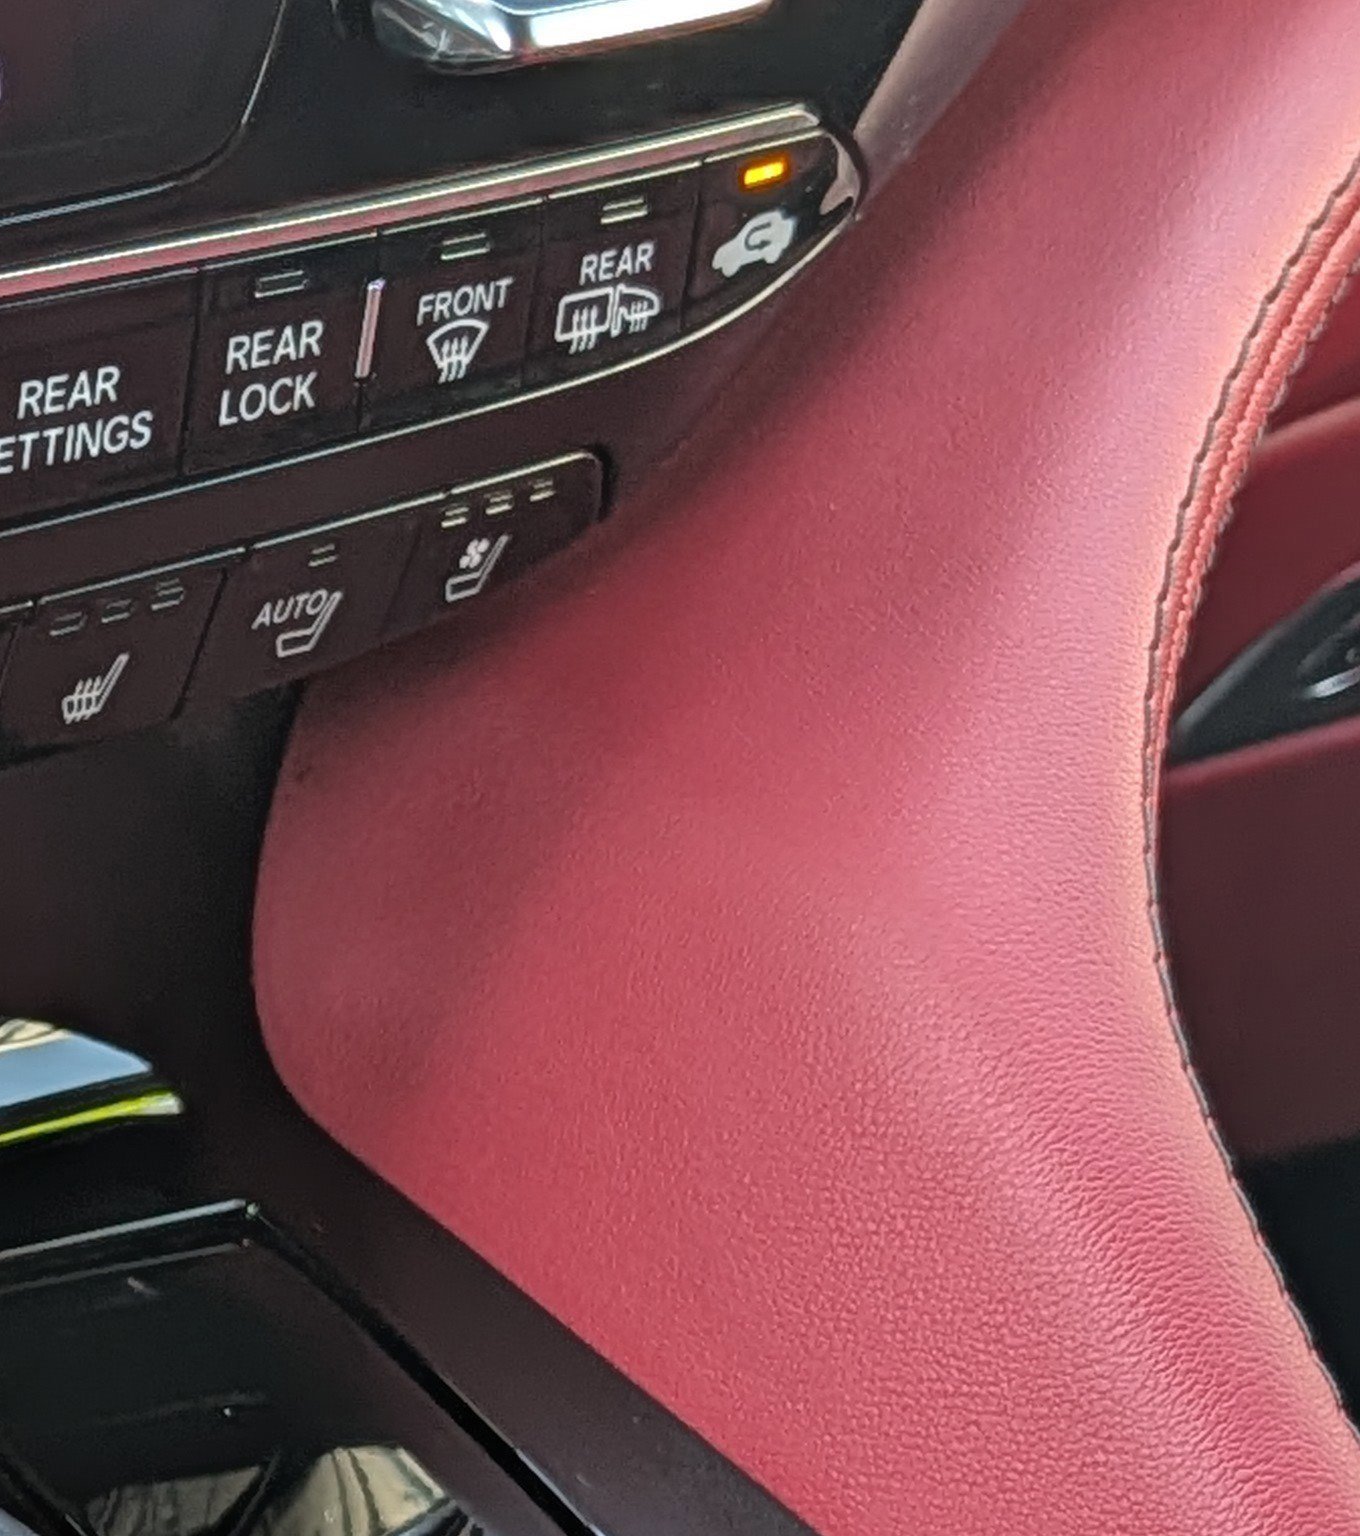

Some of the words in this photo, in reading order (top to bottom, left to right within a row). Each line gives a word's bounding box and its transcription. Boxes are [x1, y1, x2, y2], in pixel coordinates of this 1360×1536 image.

[579, 241, 655, 285] REAR
[416, 276, 514, 328] FRONT
[225, 319, 324, 375] REAR
[16, 364, 121, 420] REAR
[218, 370, 318, 427] LOCK
[250, 587, 327, 630] AUTO
